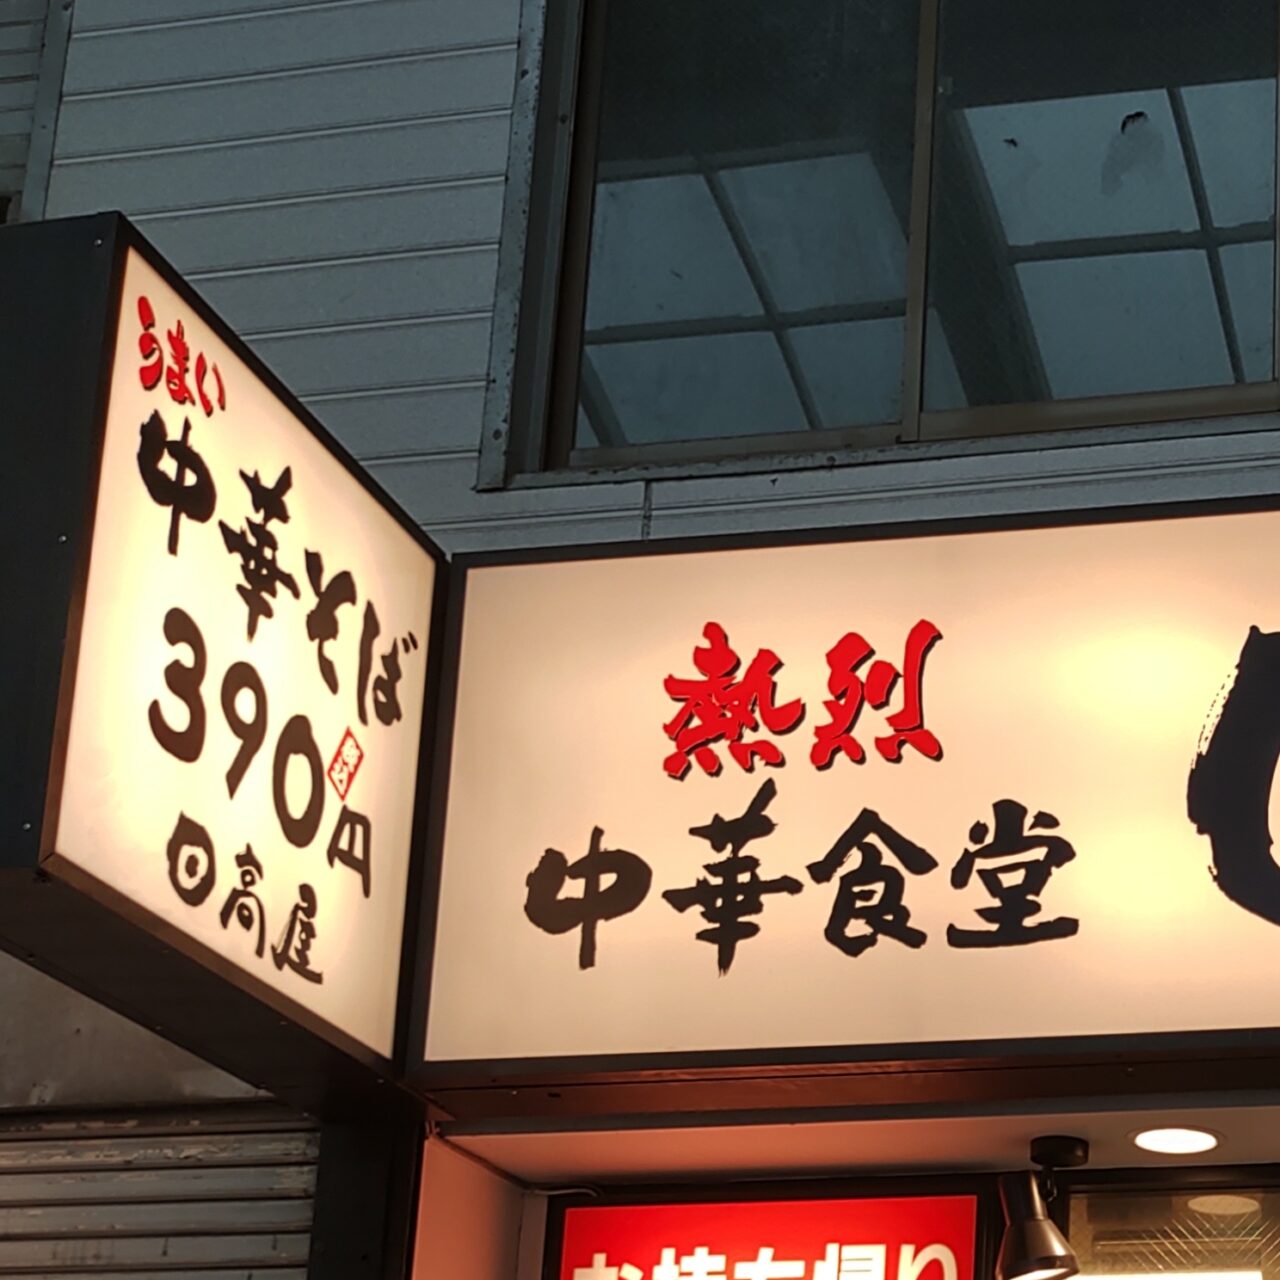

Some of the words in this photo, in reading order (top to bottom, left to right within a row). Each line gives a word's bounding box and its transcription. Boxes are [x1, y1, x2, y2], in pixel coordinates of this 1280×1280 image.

[137, 295, 226, 418] うまい
[137, 408, 418, 727] 中華そば
[149, 607, 371, 898] 390円
[662, 619, 943, 781] 熱烈
[167, 812, 324, 984] 日高屋
[524, 779, 1078, 976] 中華食堂
